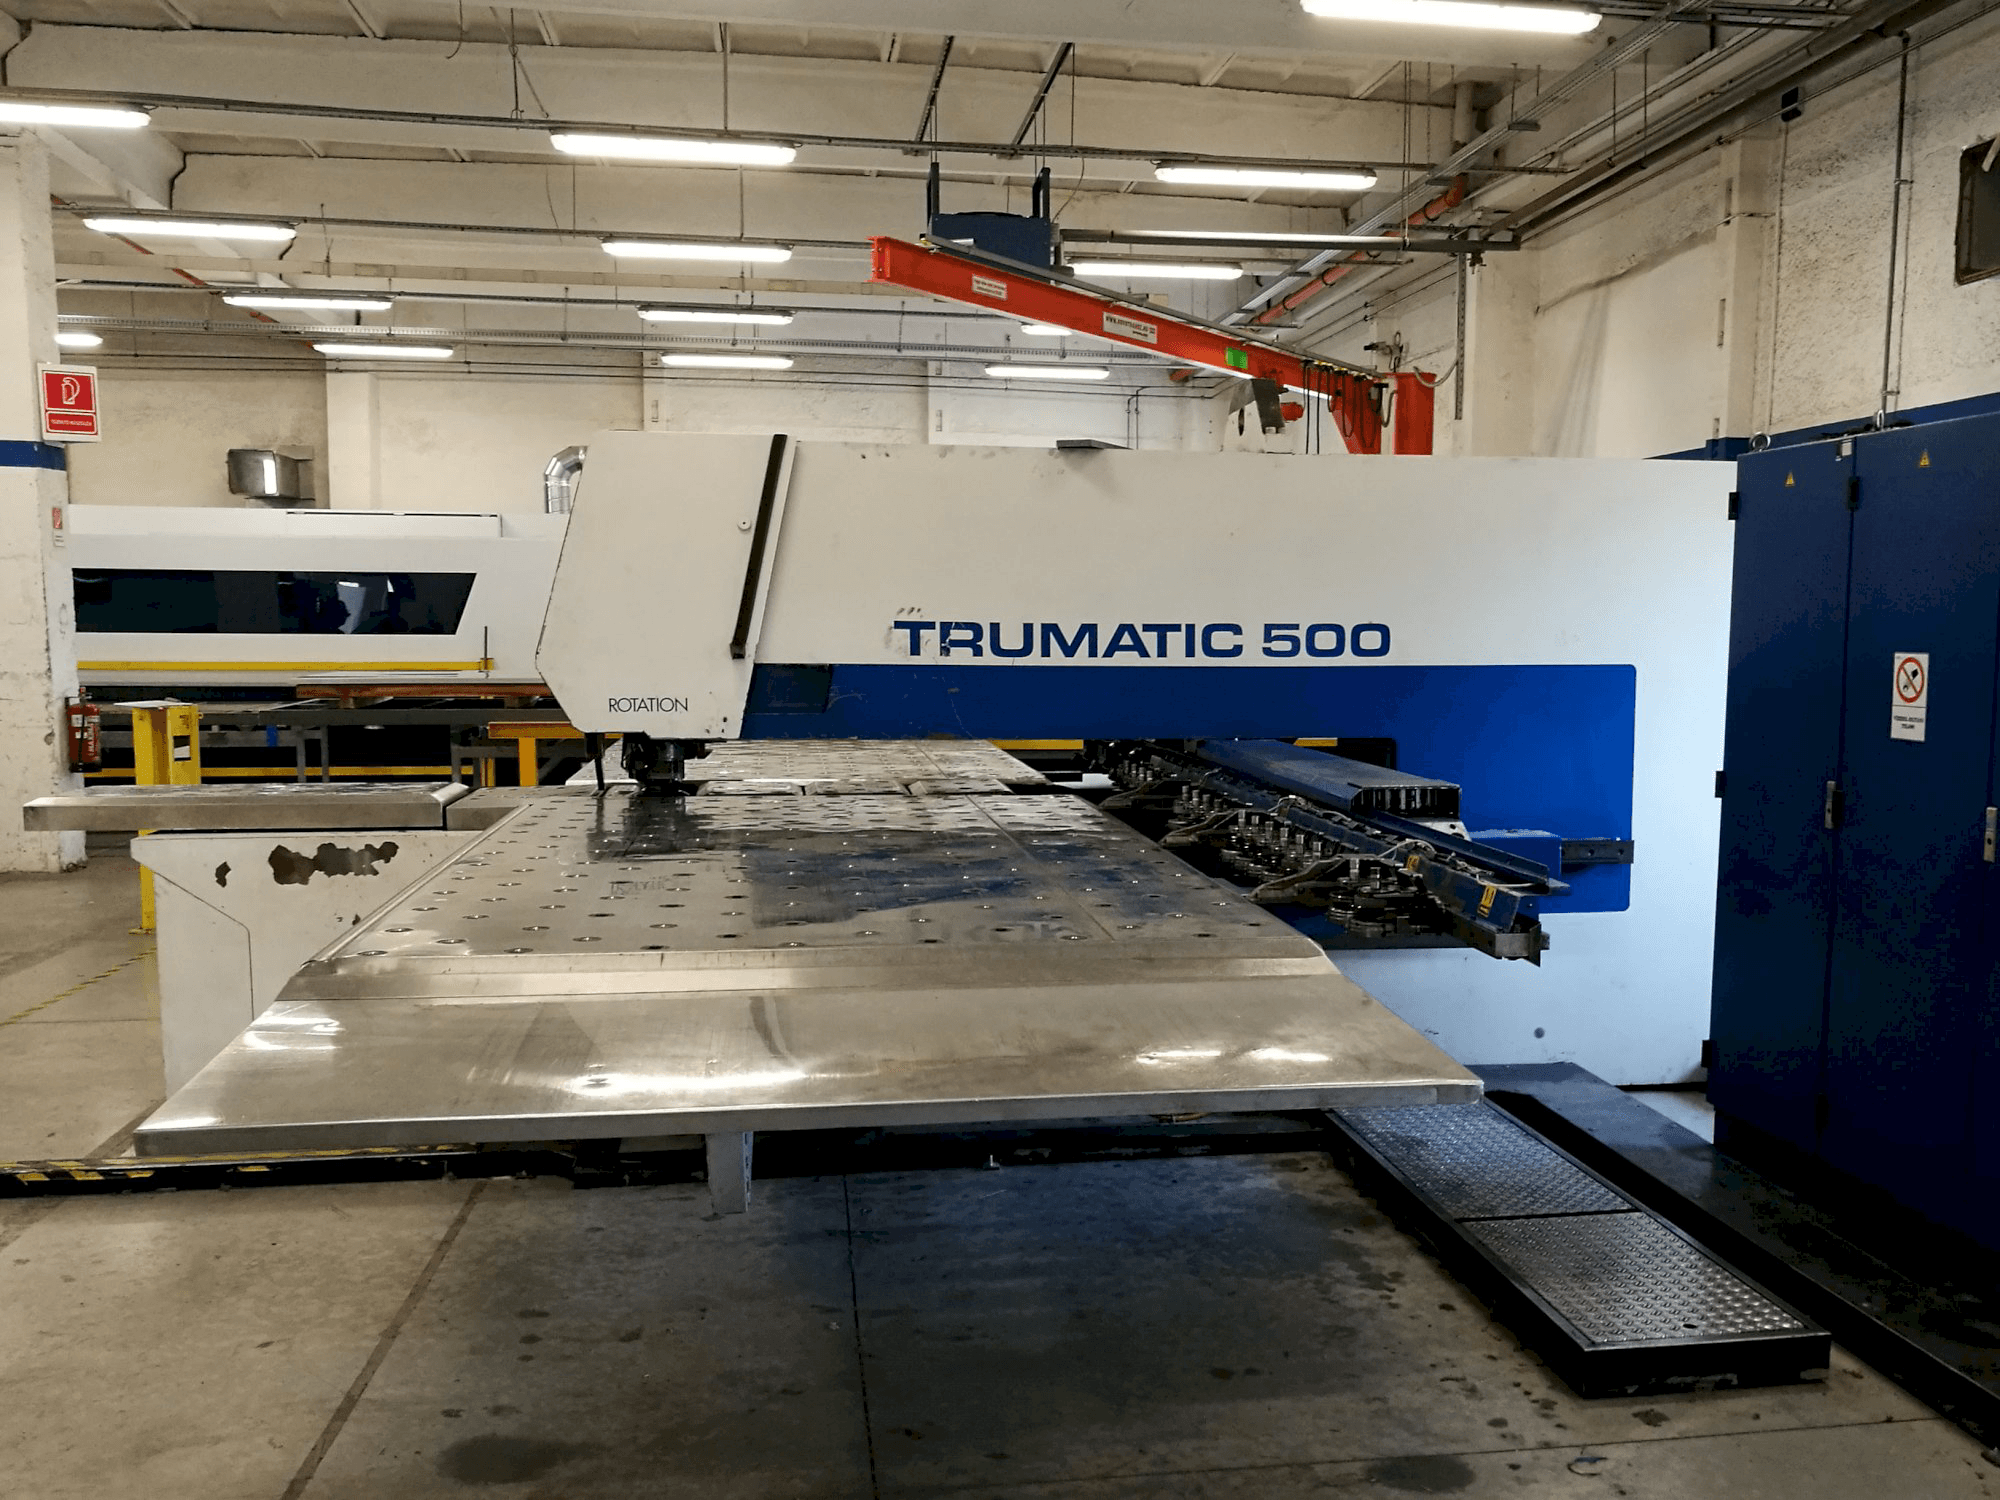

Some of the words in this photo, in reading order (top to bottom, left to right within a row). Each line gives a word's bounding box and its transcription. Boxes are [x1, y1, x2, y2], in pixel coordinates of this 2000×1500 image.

[893, 620, 1244, 659] TRUMATIC
[1261, 622, 1392, 659] 500
[608, 697, 688, 712] ROTATION
